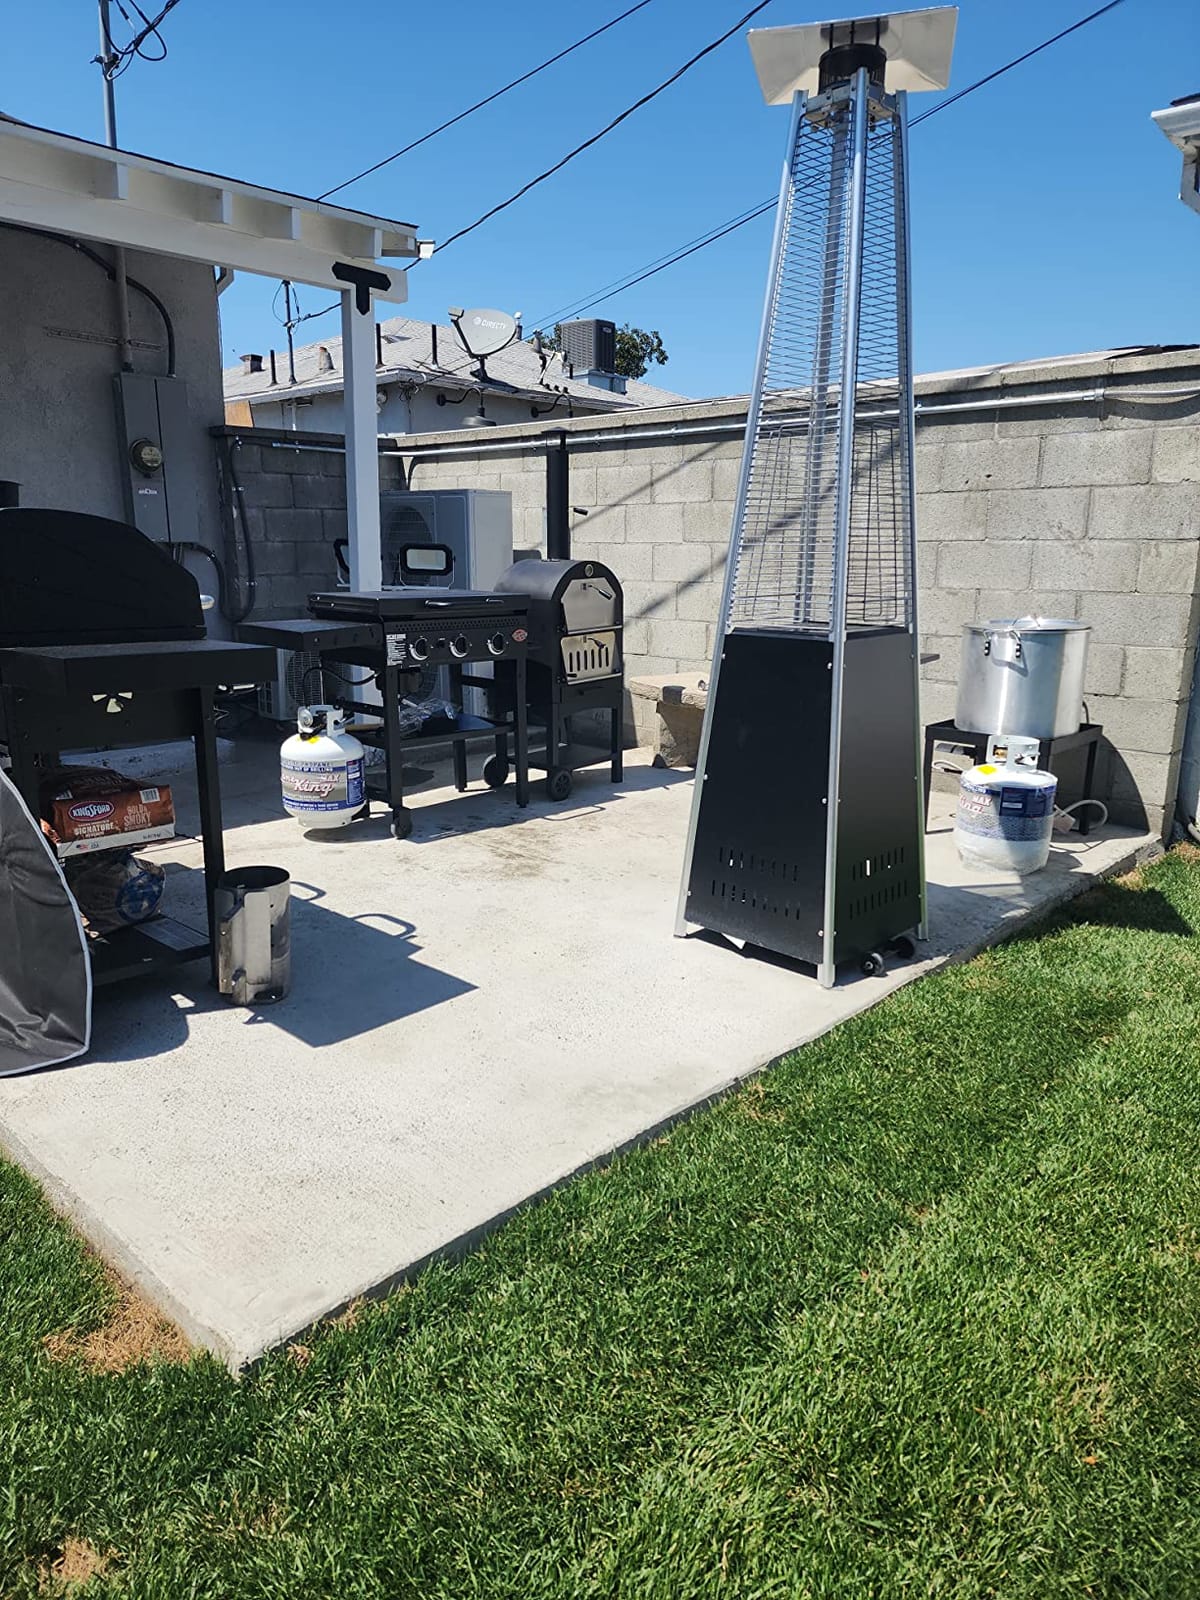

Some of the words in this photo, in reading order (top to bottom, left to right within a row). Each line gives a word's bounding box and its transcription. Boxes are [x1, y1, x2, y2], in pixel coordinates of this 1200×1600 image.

[294, 779, 334, 797] King
[72, 805, 111, 817] KINGSFORD
[123, 811, 151, 826] SMOKY
[74, 822, 114, 835] SIGNATURE
